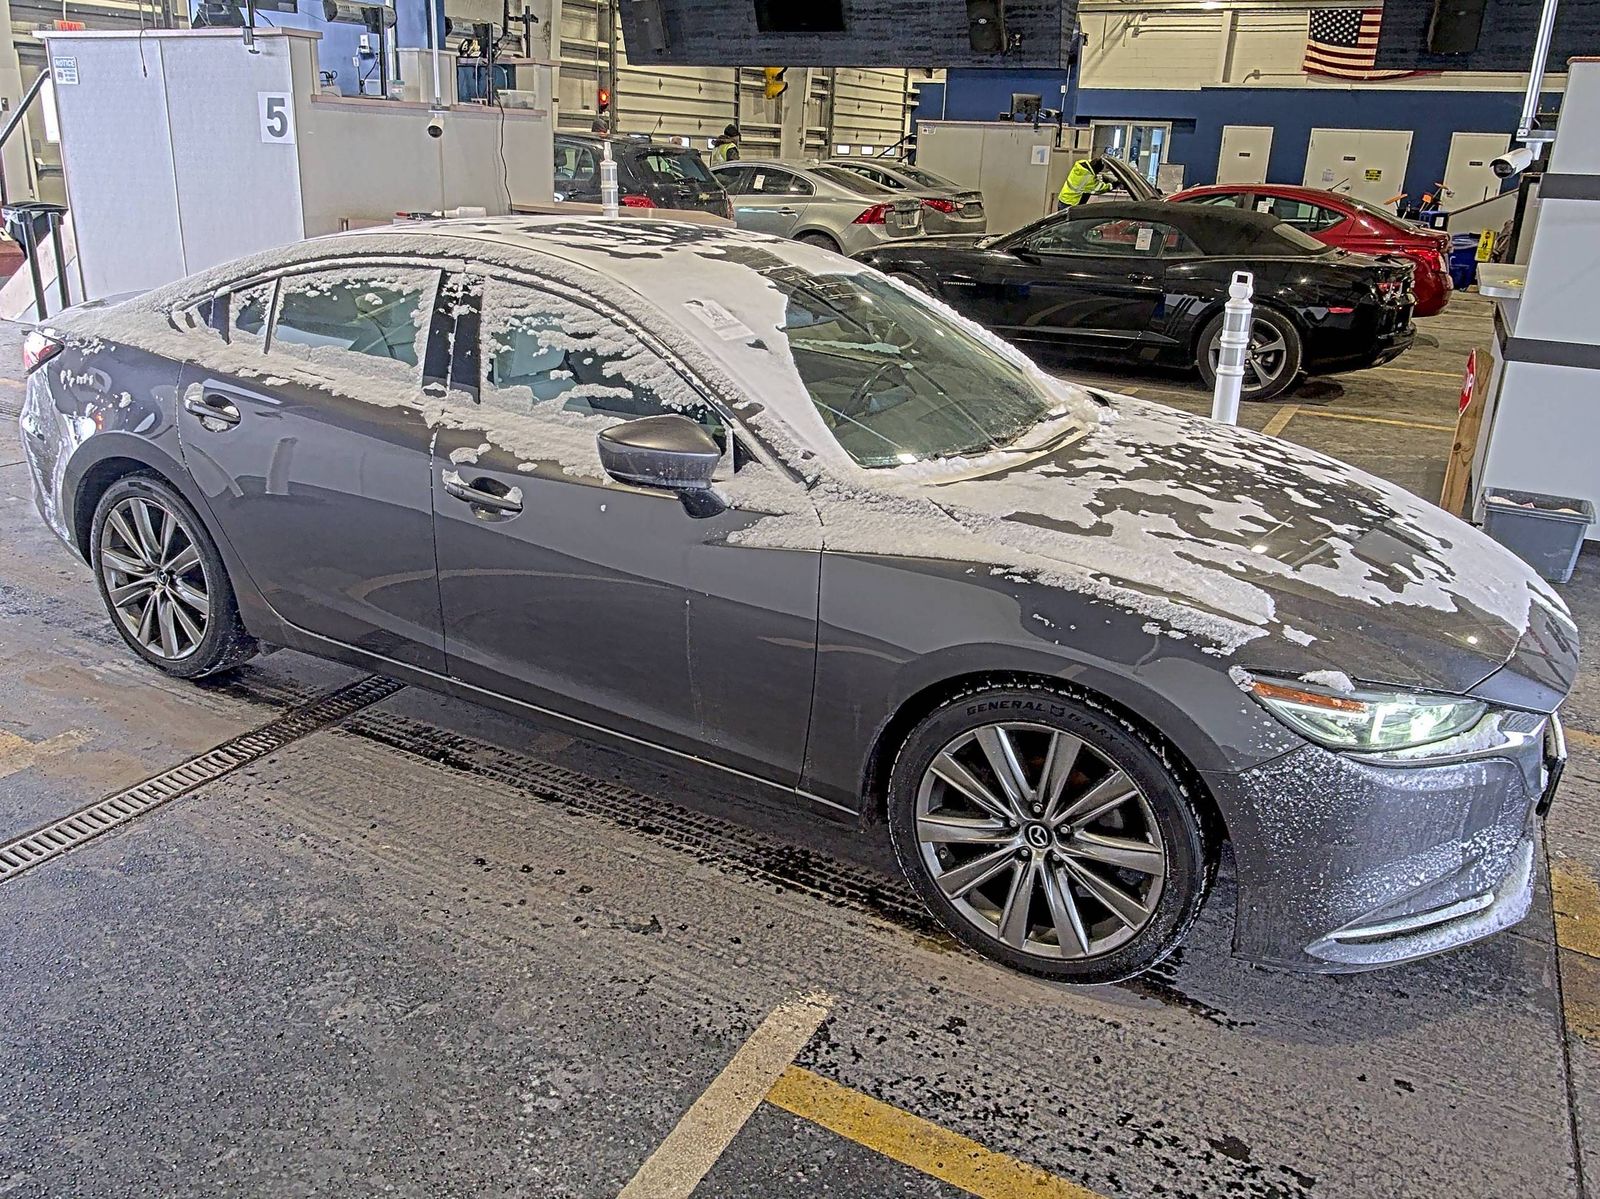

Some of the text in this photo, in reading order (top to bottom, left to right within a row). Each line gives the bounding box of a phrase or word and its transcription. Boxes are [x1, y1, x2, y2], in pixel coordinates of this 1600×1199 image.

[266, 97, 289, 138] 5
[1036, 148, 1046, 164] 1
[966, 700, 1046, 716] GENERAL
